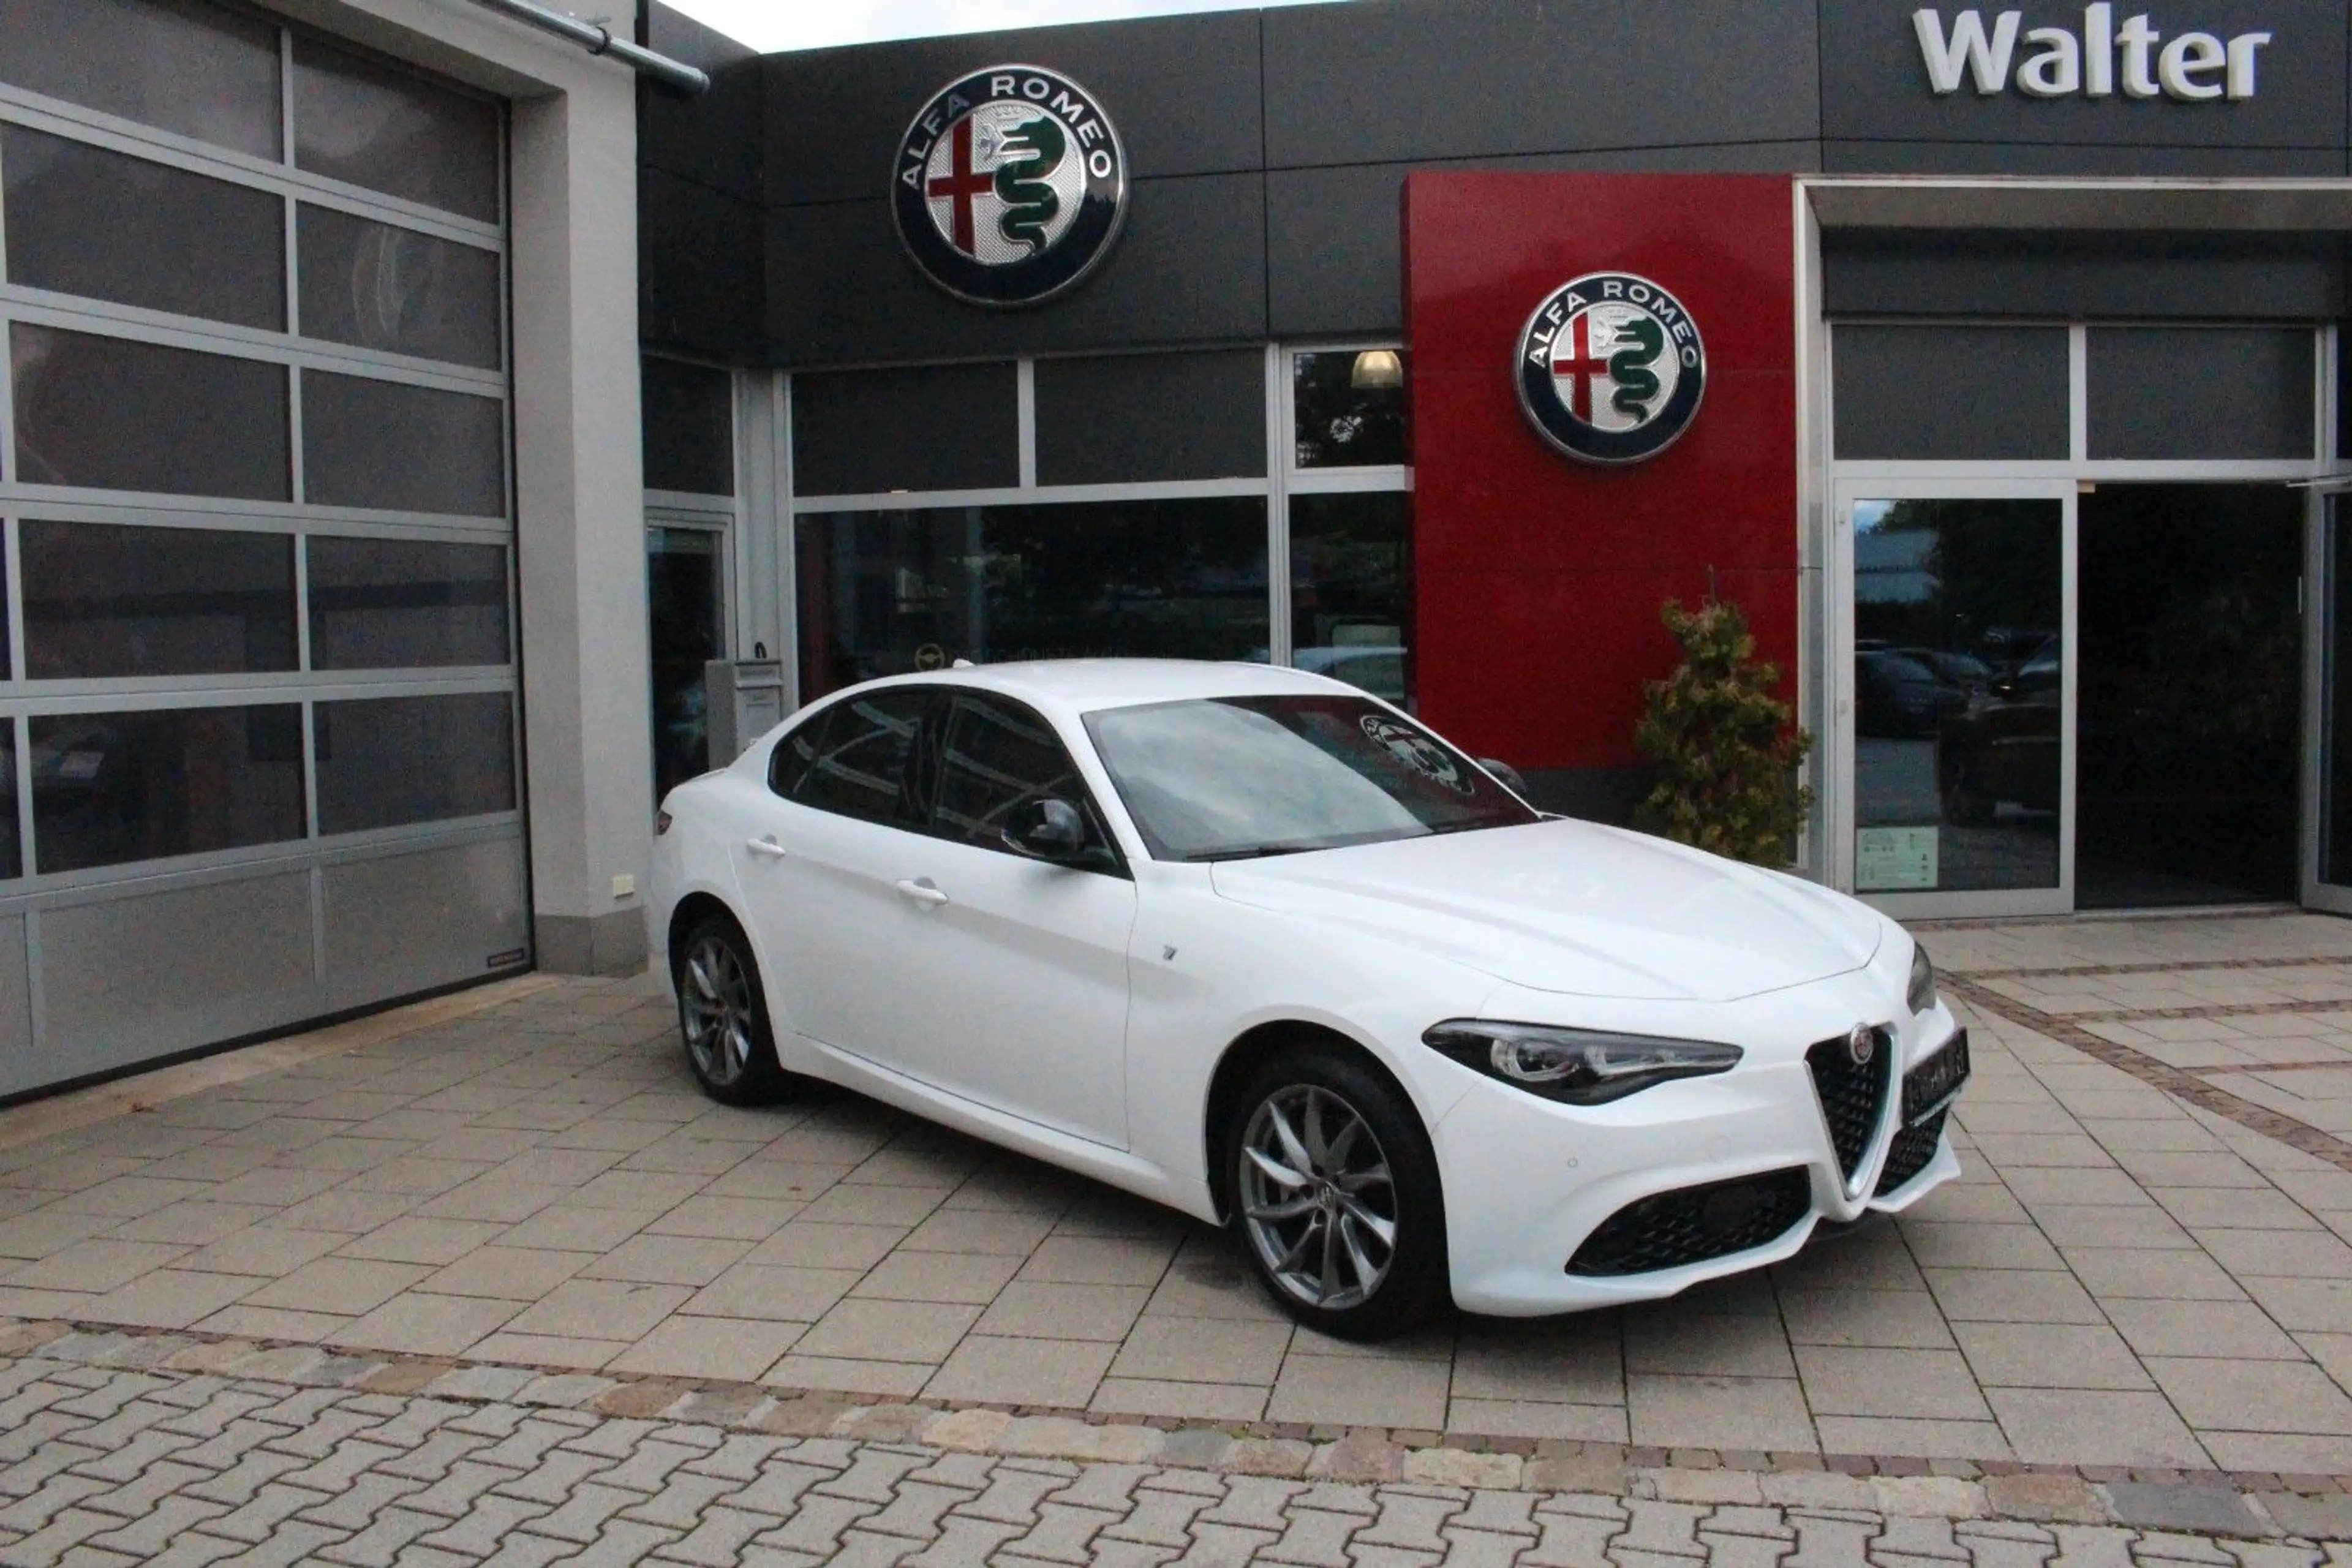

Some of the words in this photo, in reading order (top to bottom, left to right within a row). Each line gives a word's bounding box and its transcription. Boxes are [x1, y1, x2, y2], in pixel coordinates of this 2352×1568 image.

[1912, 2, 2272, 100] Walter
[902, 93, 970, 190] ALFA
[990, 75, 1112, 178] ROMEO
[1529, 292, 1587, 368] ALFA
[1603, 281, 1698, 368] ROMEO
